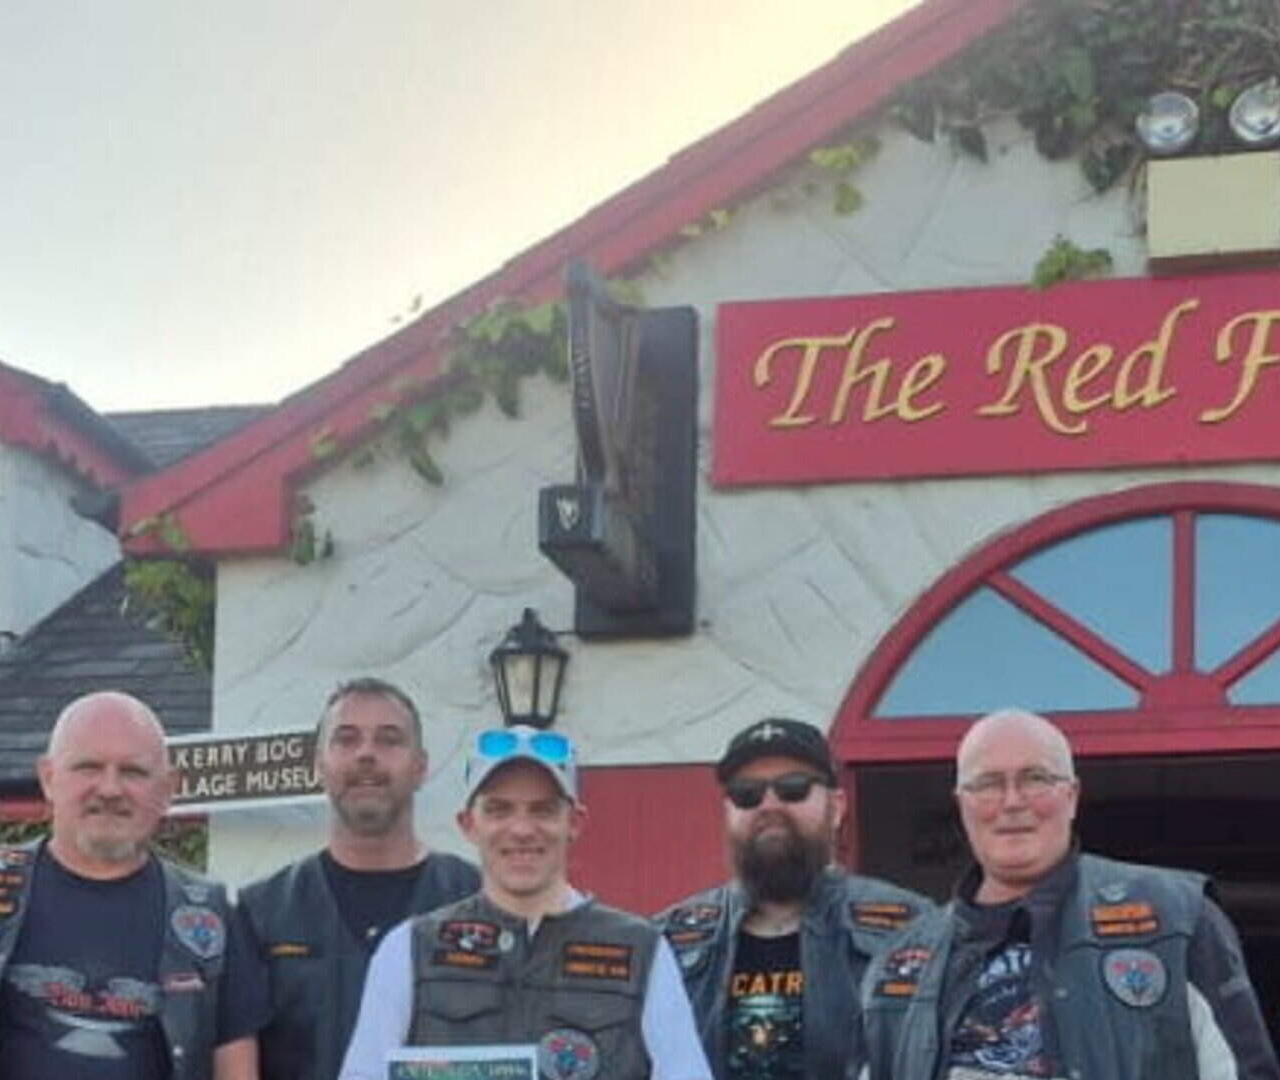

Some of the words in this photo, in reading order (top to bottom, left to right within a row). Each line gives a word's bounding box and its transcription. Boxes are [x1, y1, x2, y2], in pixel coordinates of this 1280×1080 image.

[753, 317, 945, 430] The
[978, 298, 1200, 437] Red
[175, 744, 248, 770] KERRY
[255, 738, 304, 763] BOG
[180, 773, 238, 798] LAGE
[245, 766, 319, 792] MUSEU
[731, 972, 806, 997] CATR
